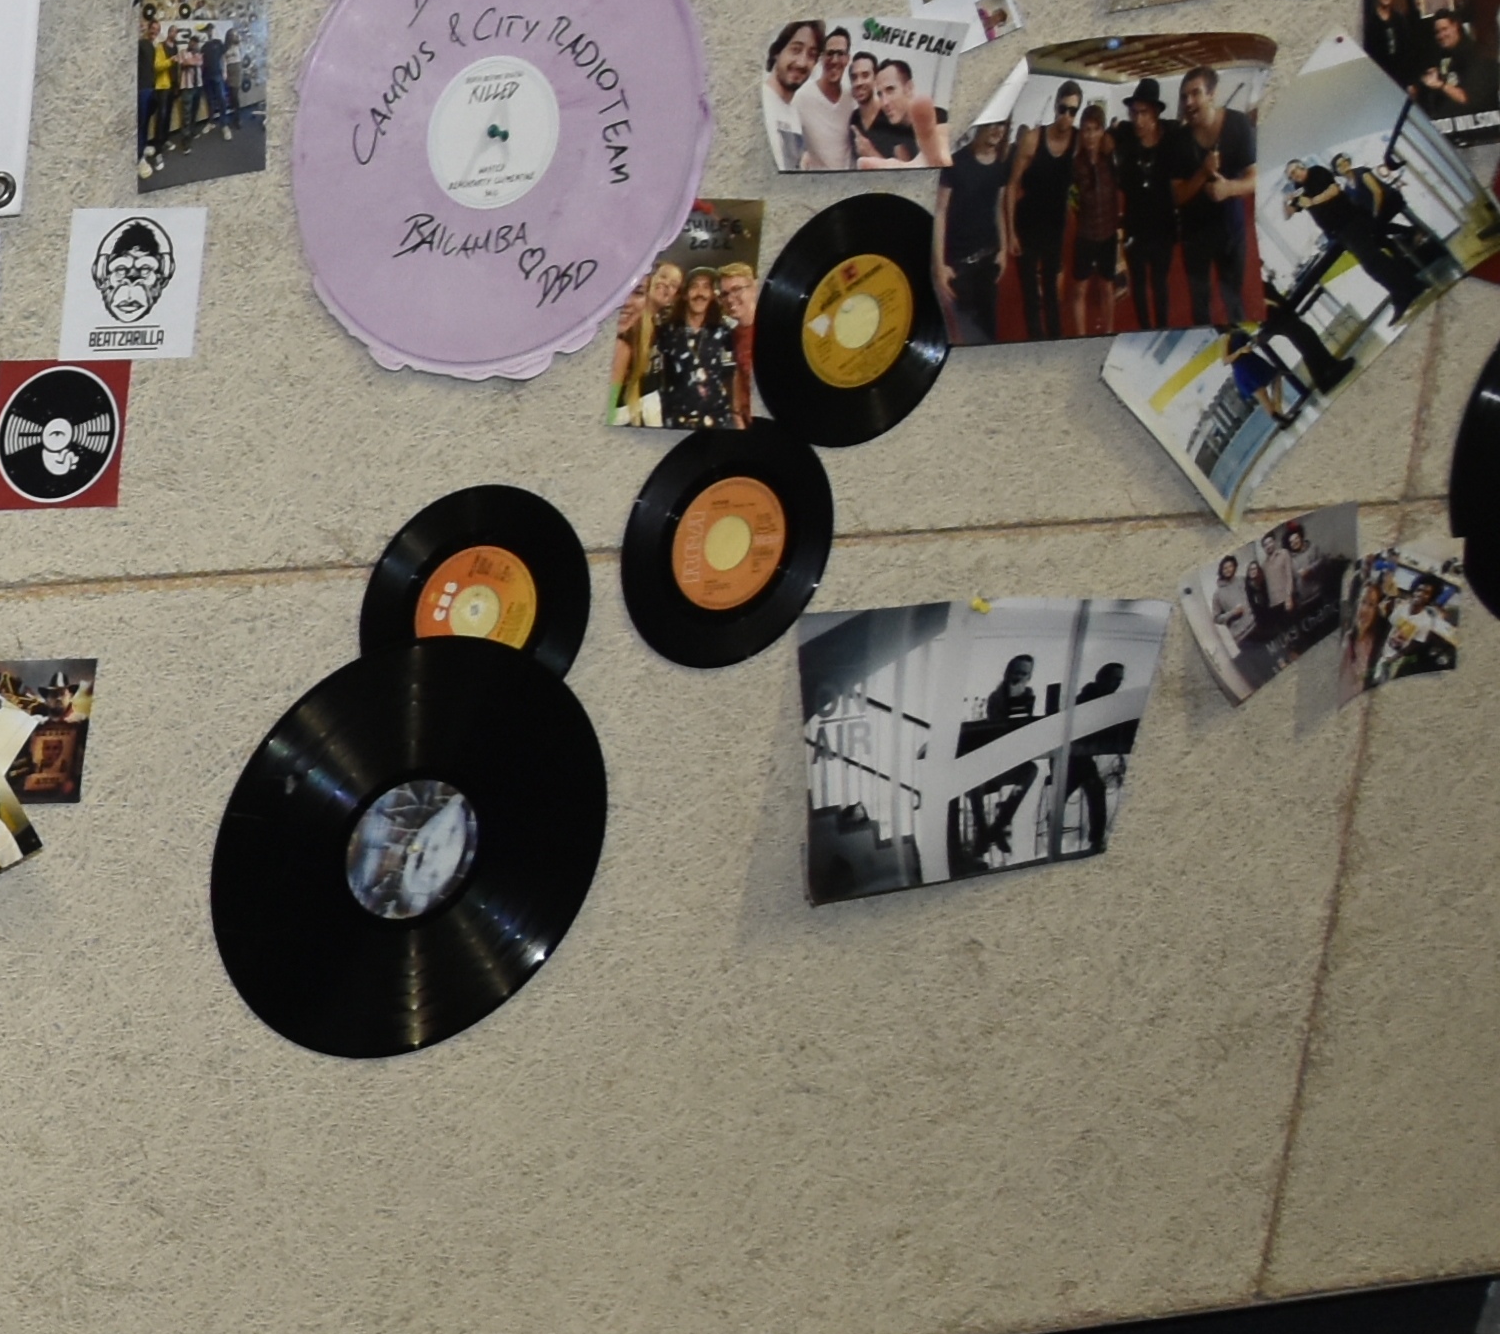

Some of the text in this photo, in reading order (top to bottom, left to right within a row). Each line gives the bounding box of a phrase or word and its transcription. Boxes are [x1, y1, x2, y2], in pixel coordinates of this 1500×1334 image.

[352, 40, 436, 165] CAMPUS
[473, 6, 541, 43] CITY
[467, 80, 521, 105] KILLED
[88, 329, 165, 349] BEATZARILLA
[810, 721, 873, 766] AIR
